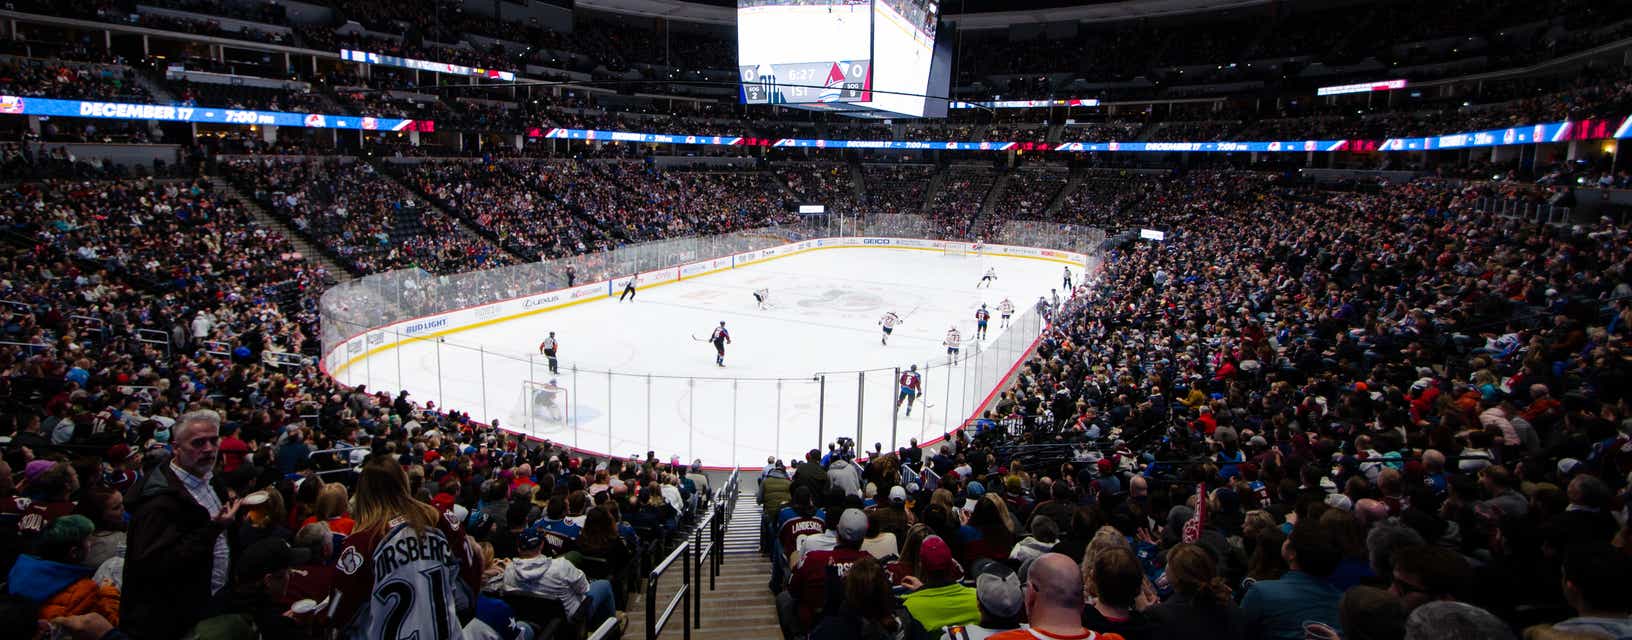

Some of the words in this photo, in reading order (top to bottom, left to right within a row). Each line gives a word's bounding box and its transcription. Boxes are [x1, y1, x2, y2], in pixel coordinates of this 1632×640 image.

[745, 67, 754, 82] 0
[788, 69, 816, 82] 6:27
[852, 64, 863, 78] 0
[752, 92, 758, 100] 2
[791, 86, 809, 97] 1ST
[80, 101, 176, 120] DECEMBER
[178, 108, 194, 121] 17
[224, 110, 257, 123] 7:00
[1145, 143, 1193, 151] DECEMBER
[1217, 142, 1236, 151] 7:00
[406, 322, 424, 334] BUD
[424, 318, 448, 330] LIGHT
[373, 564, 452, 640] 21
